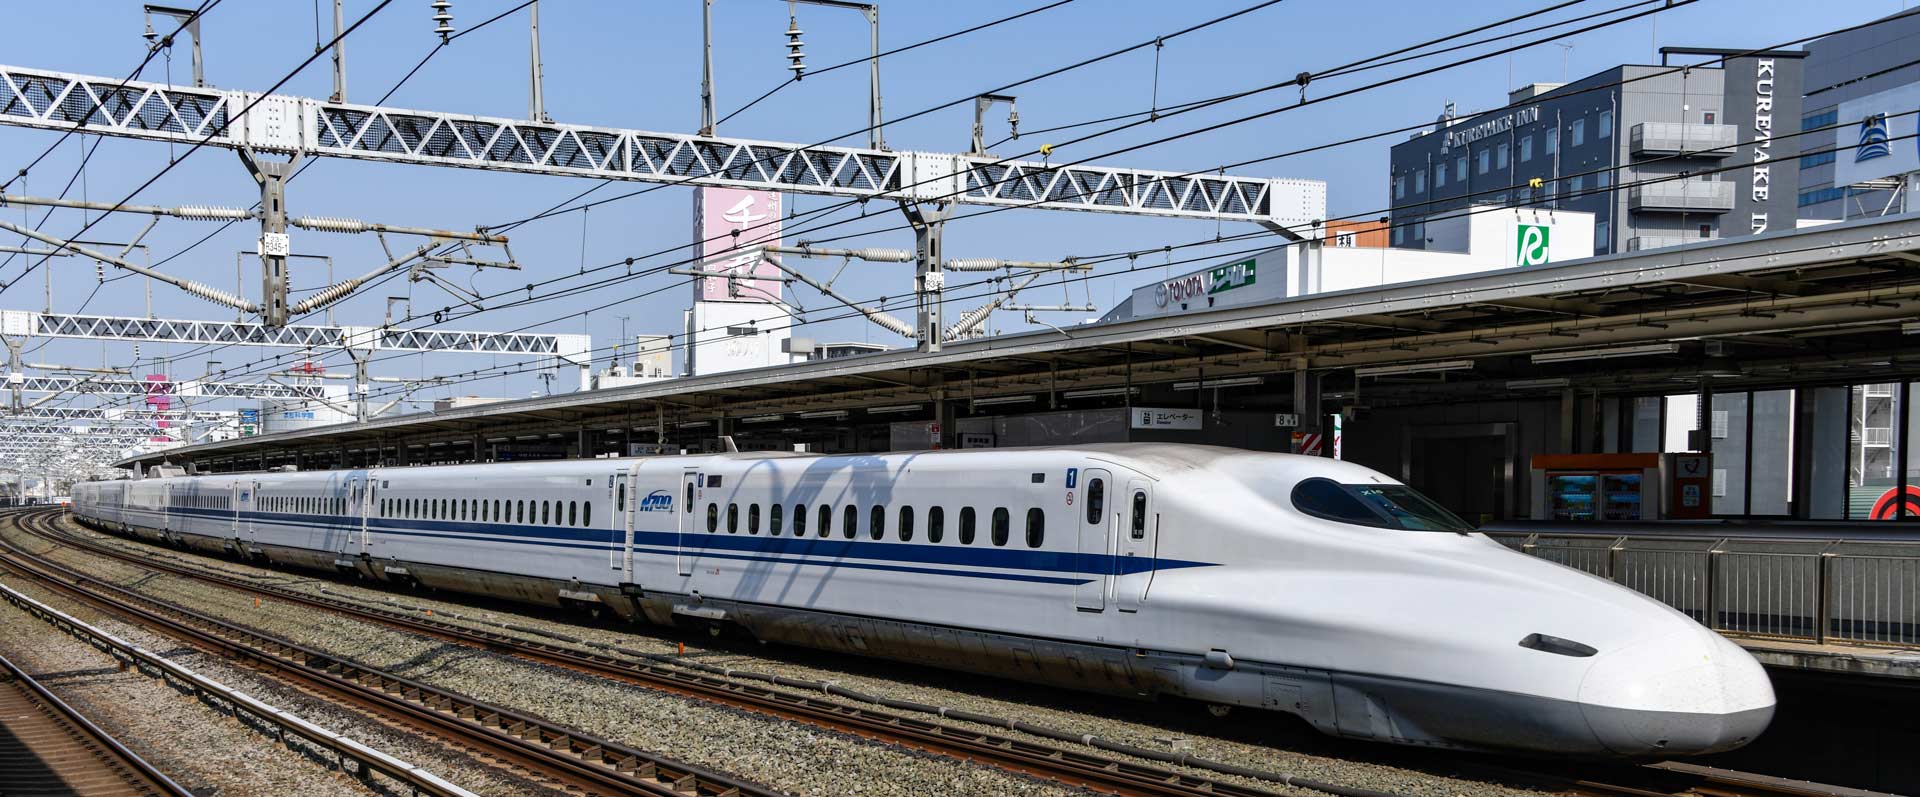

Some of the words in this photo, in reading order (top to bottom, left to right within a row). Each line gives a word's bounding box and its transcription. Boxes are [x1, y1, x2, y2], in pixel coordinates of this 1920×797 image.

[1454, 115, 1513, 147] KURETAKE
[1516, 105, 1539, 127] INN
[1753, 59, 1774, 201] KURETAKE
[1168, 275, 1205, 302] TOYOTA
[1208, 264, 1254, 293] レンタカー
[1156, 412, 1195, 421] エレベーター
[1279, 415, 1285, 426] 8
